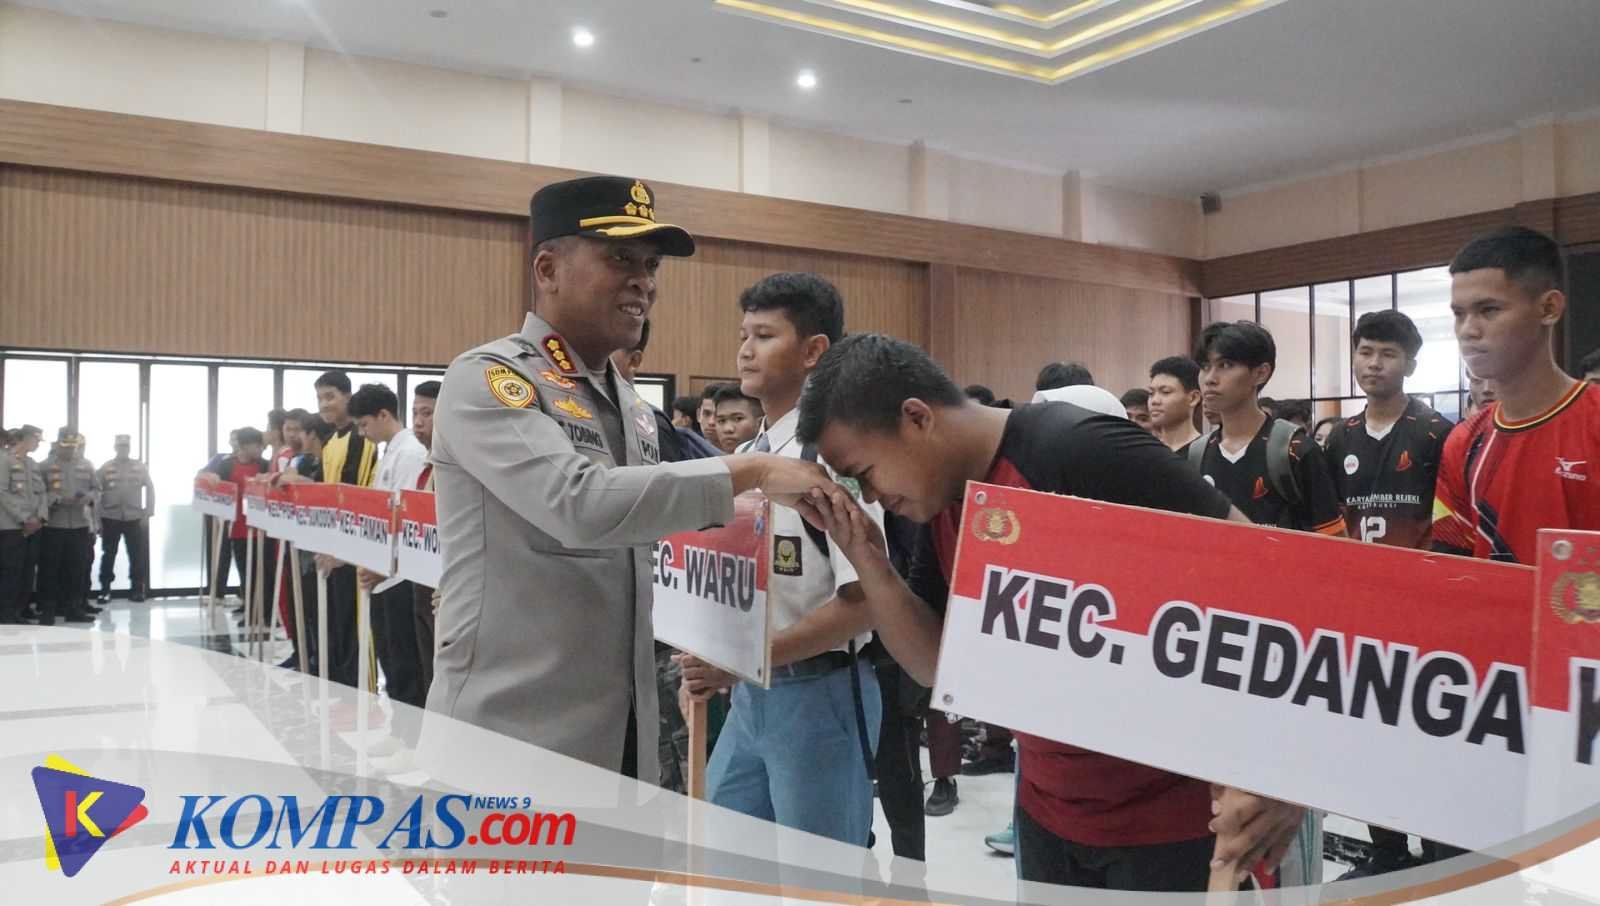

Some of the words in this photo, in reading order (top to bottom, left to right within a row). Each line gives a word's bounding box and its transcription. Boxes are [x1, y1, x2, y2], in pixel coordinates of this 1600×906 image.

[340, 511, 358, 536] KEC.
[359, 515, 388, 545] TAMAN
[402, 521, 422, 551] KEC.
[1360, 516, 1386, 543] 12
[652, 542, 678, 590] EC.
[686, 547, 755, 613] WARU
[980, 569, 1124, 666] KEC.
[1151, 605, 1527, 756] GEDANGA
